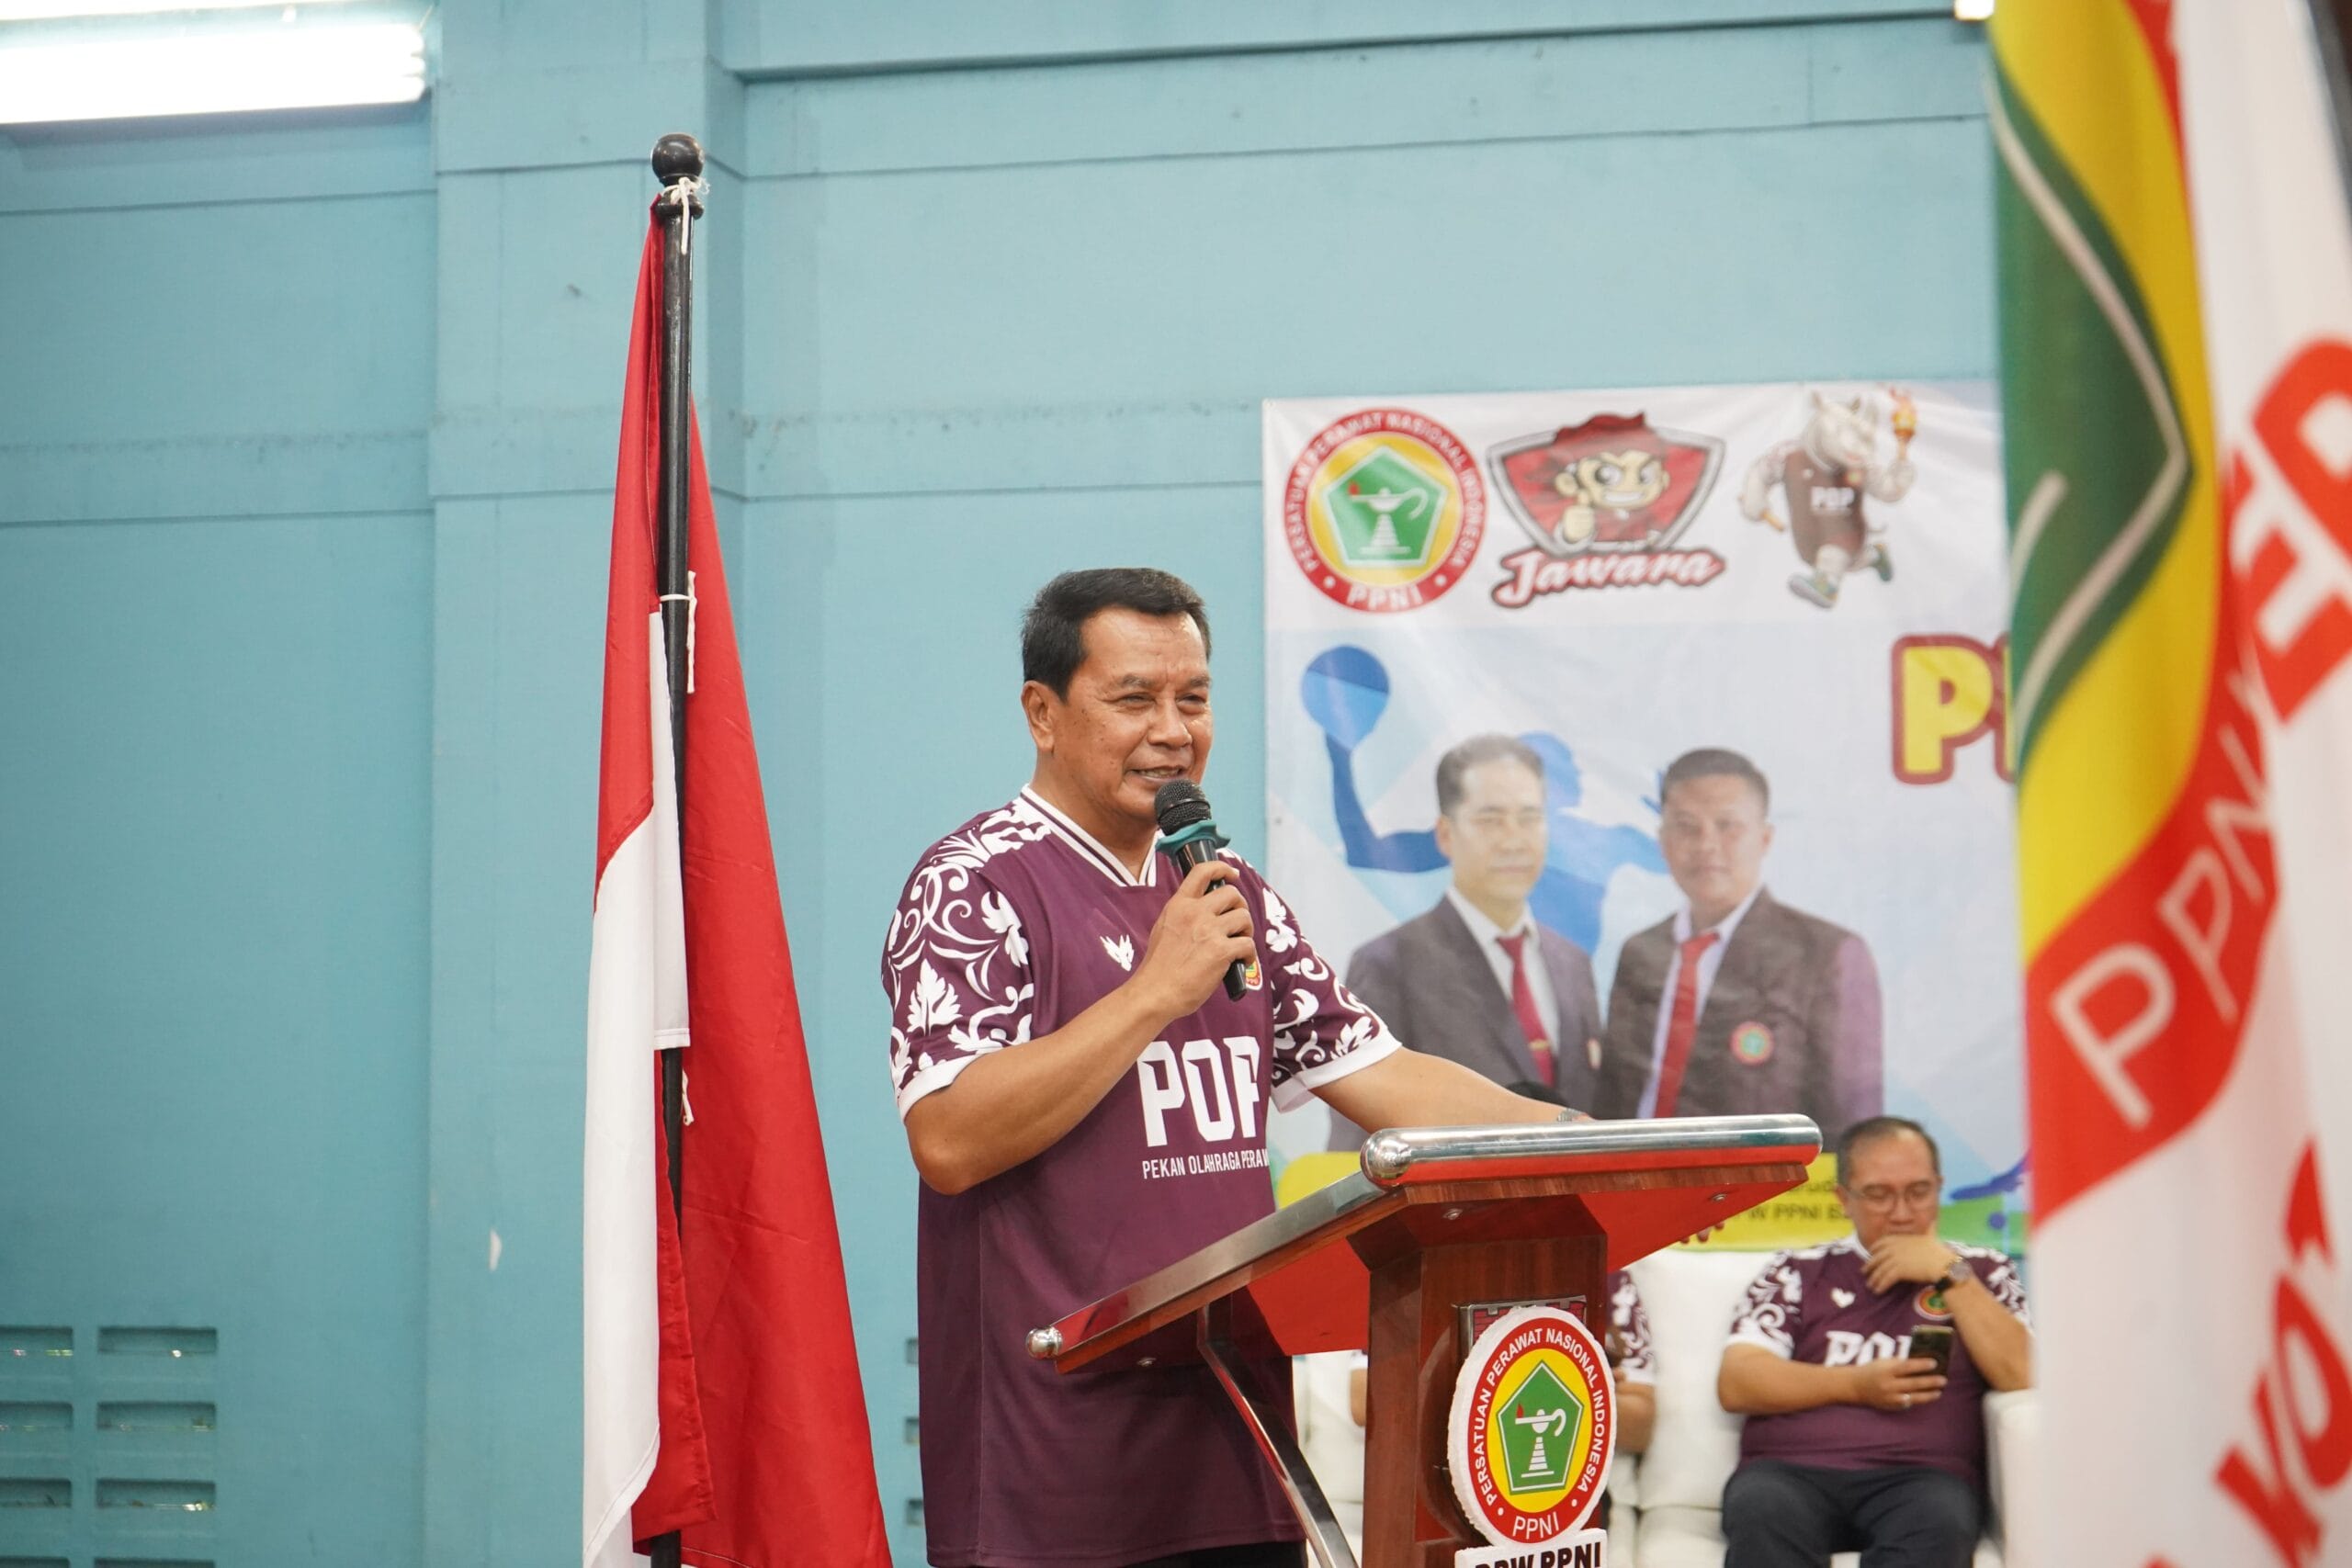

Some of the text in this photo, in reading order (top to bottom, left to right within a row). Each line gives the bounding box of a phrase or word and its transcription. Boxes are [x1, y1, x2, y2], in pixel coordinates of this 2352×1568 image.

[1346, 584, 1423, 610] PPNI
[1492, 549, 1724, 606] Jawara
[1892, 632, 2012, 785] P
[1136, 1035, 1261, 1147] POP
[1142, 1156, 1186, 1179] PEKAN
[1188, 1151, 1242, 1175] OLAHRAGA
[1473, 1328, 1605, 1507] PERSATUAN PERAWAT NASIONAL INDONESIA
[1512, 1511, 1560, 1540] PPNI
[1541, 1541, 1600, 1568] PPNI
